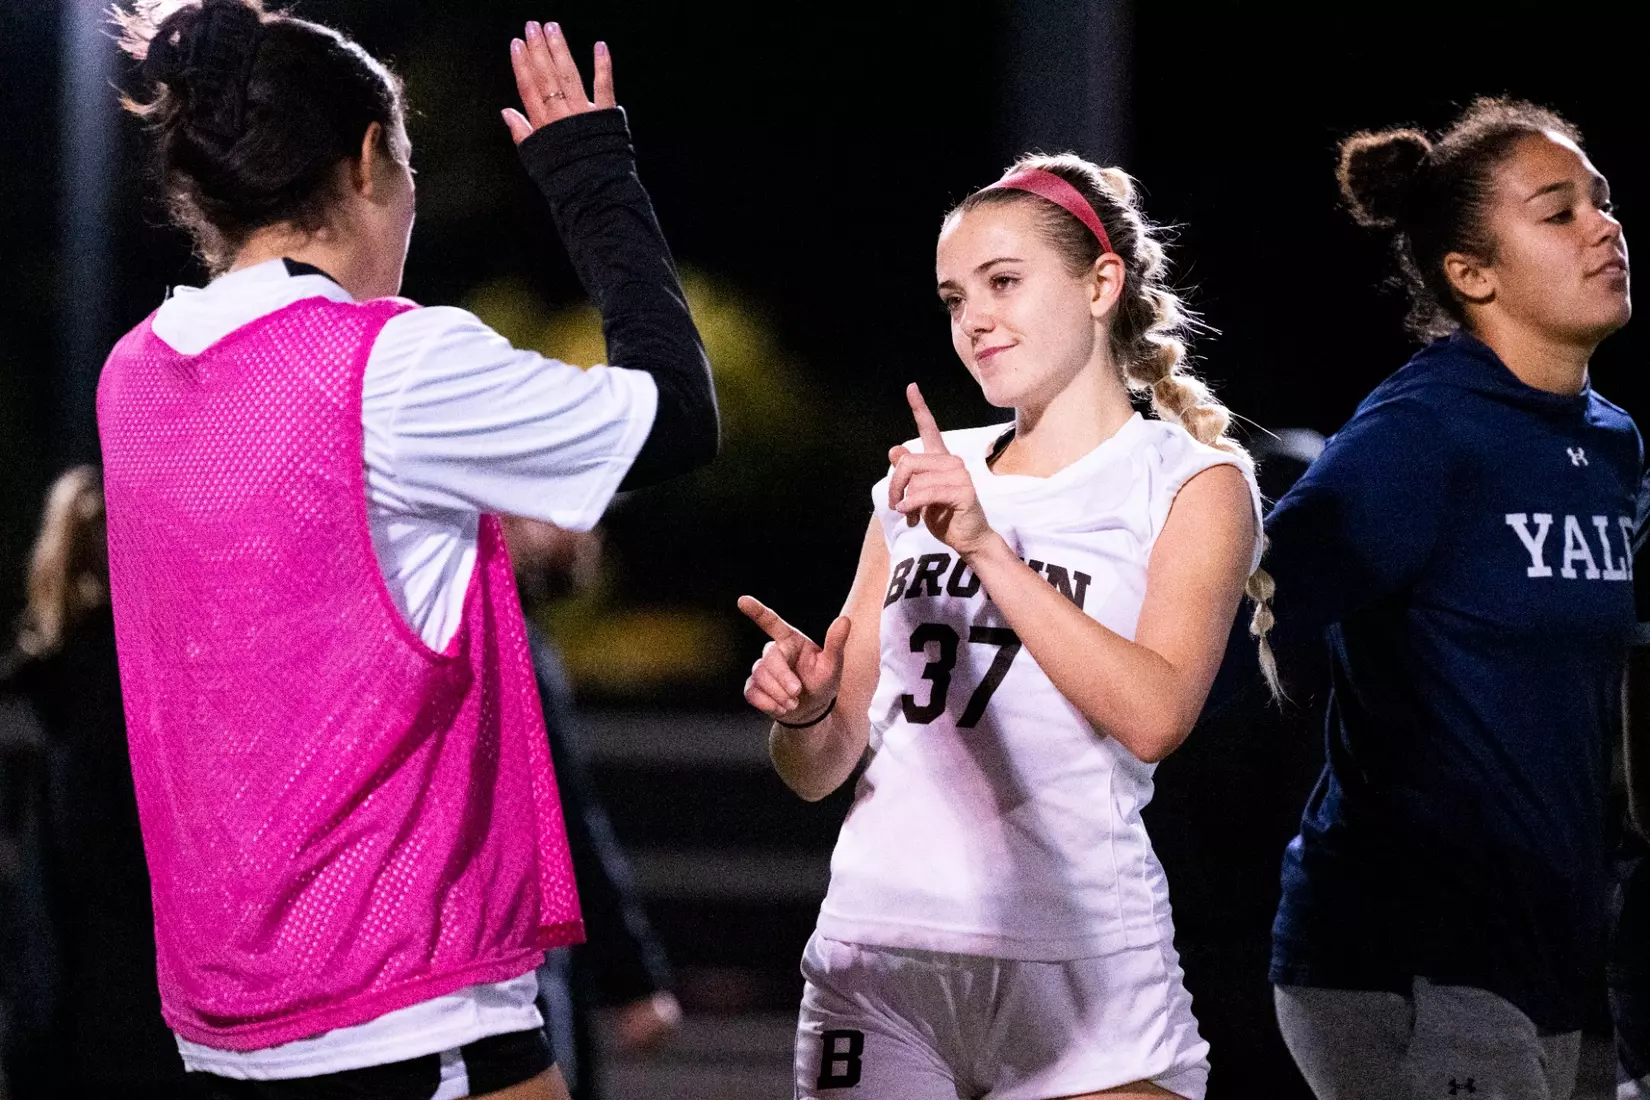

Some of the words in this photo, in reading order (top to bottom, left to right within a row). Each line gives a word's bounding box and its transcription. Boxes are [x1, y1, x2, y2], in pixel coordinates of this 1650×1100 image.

[884, 553, 1092, 610] BRON
[901, 623, 1022, 728] 37
[817, 1029, 865, 1091] B
